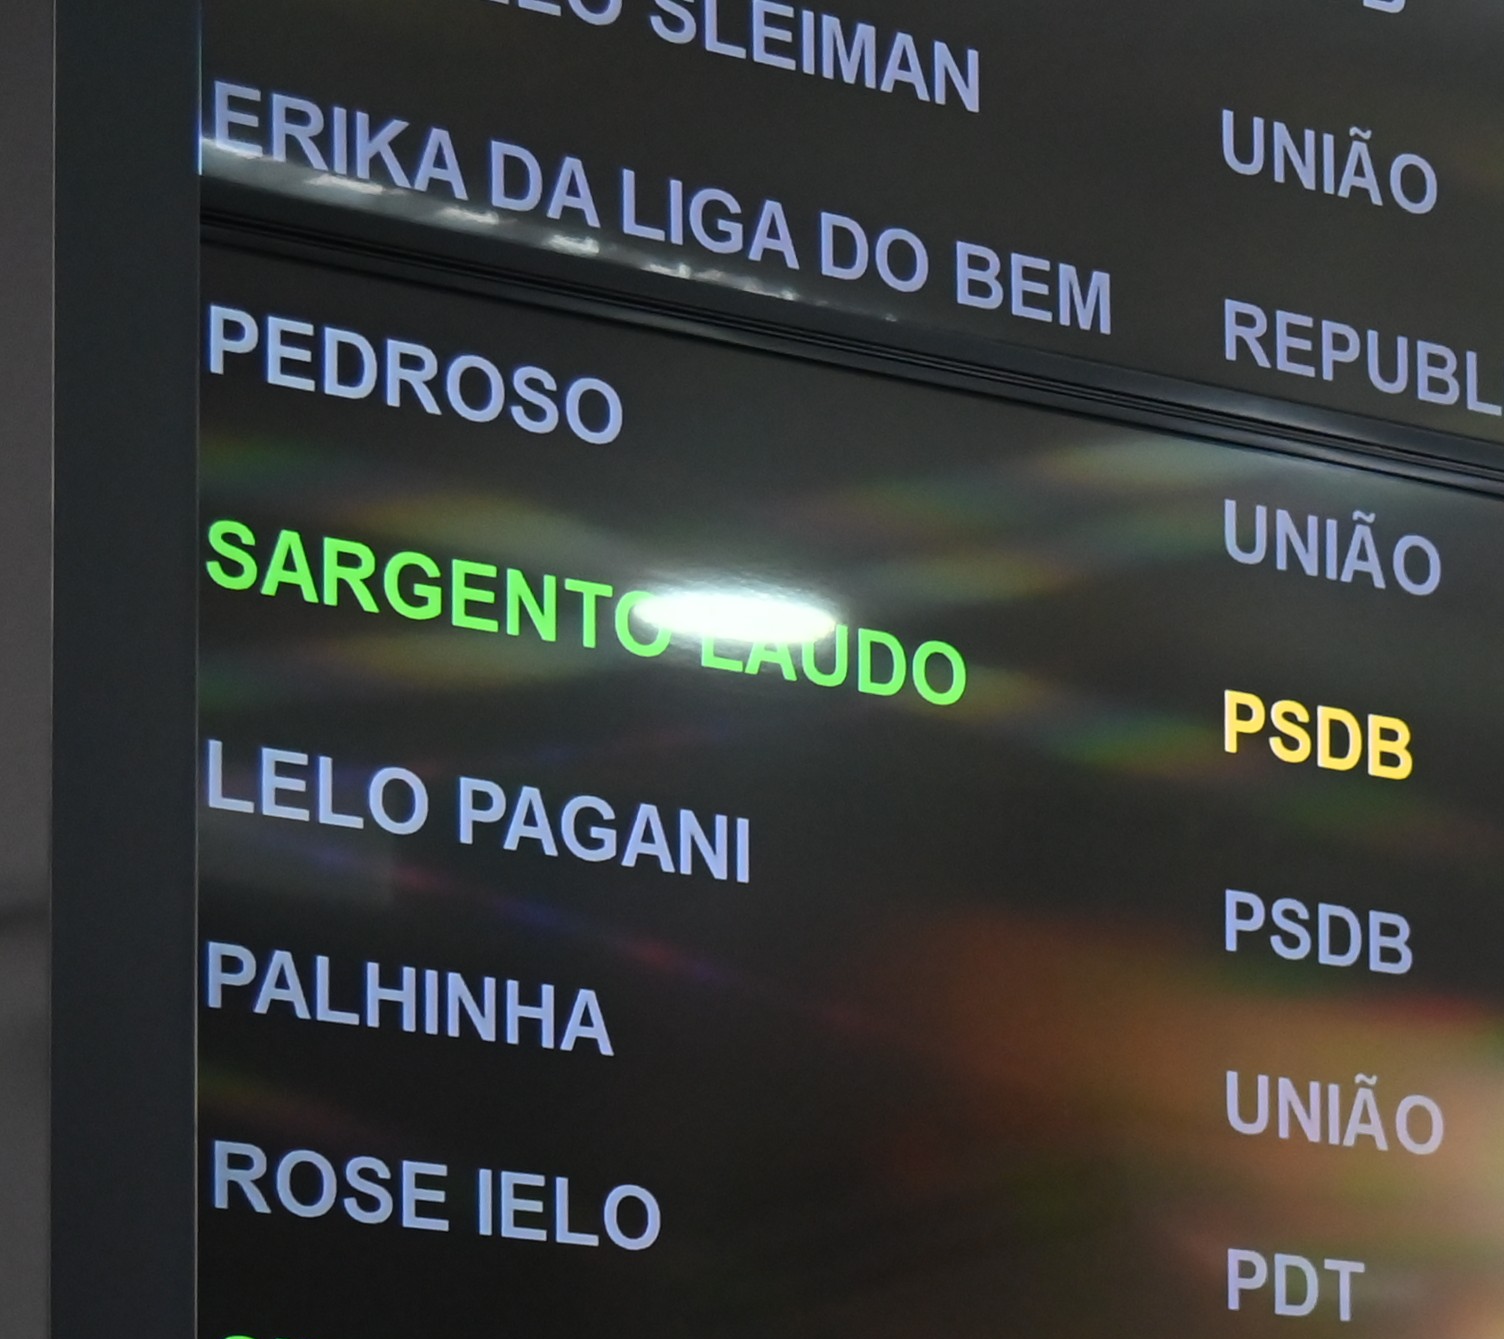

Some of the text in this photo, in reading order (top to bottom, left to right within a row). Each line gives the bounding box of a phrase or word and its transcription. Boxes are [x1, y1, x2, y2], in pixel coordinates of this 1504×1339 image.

[650, 0, 981, 113] SLEIMAN
[212, 80, 1113, 335] ERIKA DA LIGA DO BEM
[1222, 109, 1438, 214] UNIÃO
[209, 304, 624, 446] PEDROSO
[206, 520, 672, 658] SARGENTO
[1224, 498, 1442, 596] UNIÃO
[1224, 690, 1413, 780] PSDB
[205, 739, 751, 885] LELO PAGANI
[1224, 888, 1413, 975] PSDB
[206, 941, 614, 1057] PALHINHA
[1225, 1071, 1445, 1155] UNIÃO
[212, 1140, 662, 1251] ROSE IELO
[1227, 1248, 1366, 1322] PDT
